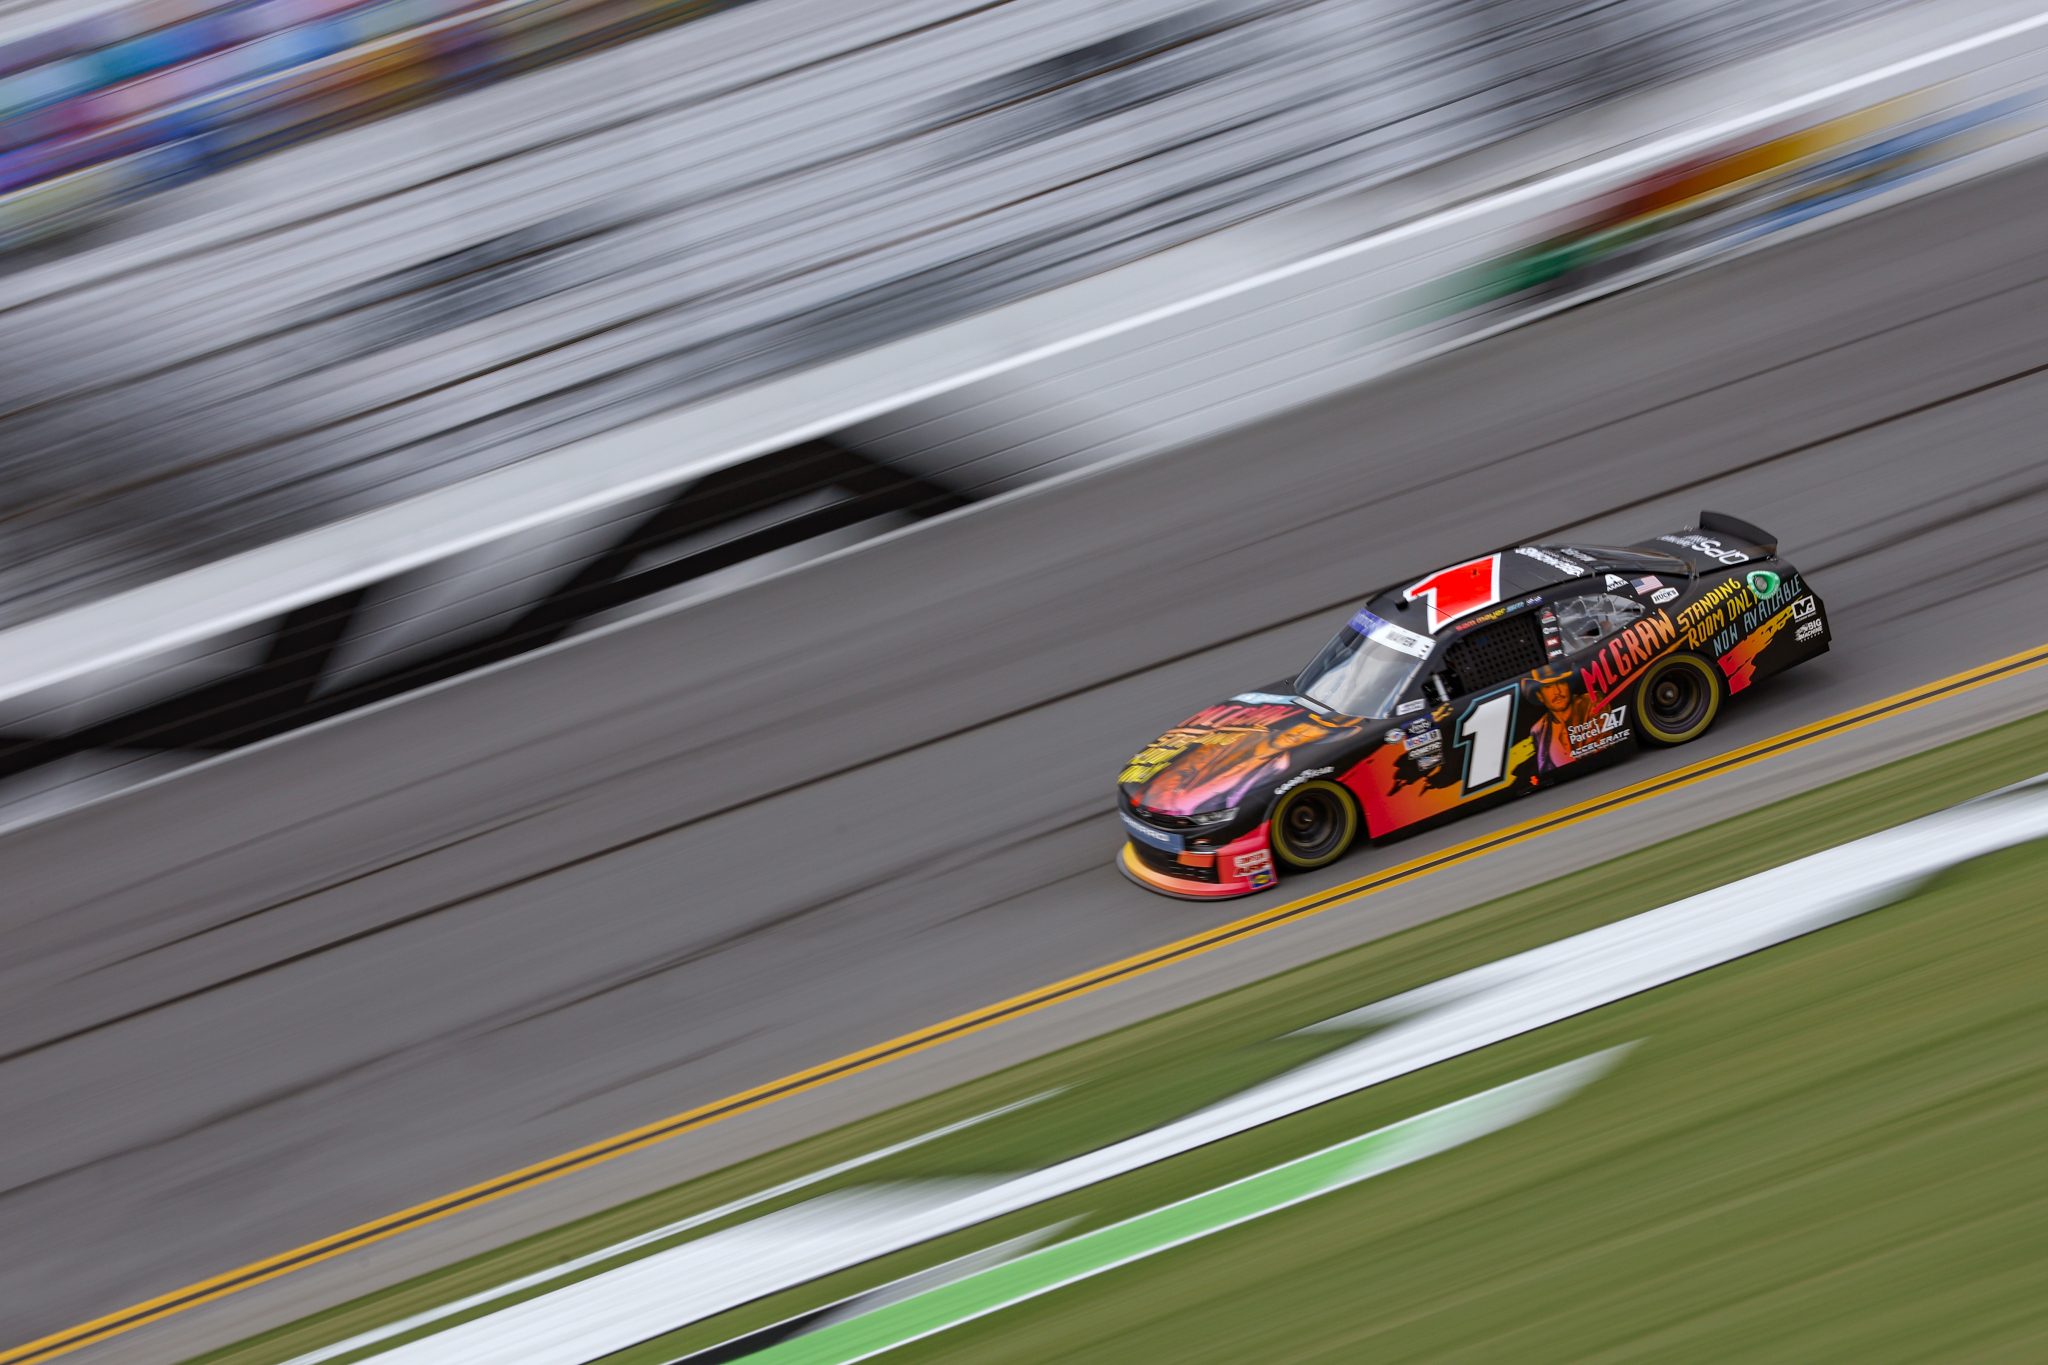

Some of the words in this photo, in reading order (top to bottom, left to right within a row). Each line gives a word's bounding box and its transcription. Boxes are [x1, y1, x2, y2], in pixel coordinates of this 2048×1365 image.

[1692, 540, 1749, 565] QPS
[1403, 552, 1501, 634] 1
[1677, 578, 1741, 632] STANDING
[1688, 609, 1725, 650] ROOM
[1713, 625, 1738, 657] NOW
[1743, 573, 1802, 632] AVAILABLE
[1807, 618, 1822, 630] BIG
[1457, 689, 1515, 793] 1
[1568, 718, 1598, 736] Smart
[1569, 723, 1600, 744] Parcel
[1571, 729, 1630, 756] ACCELERATE
